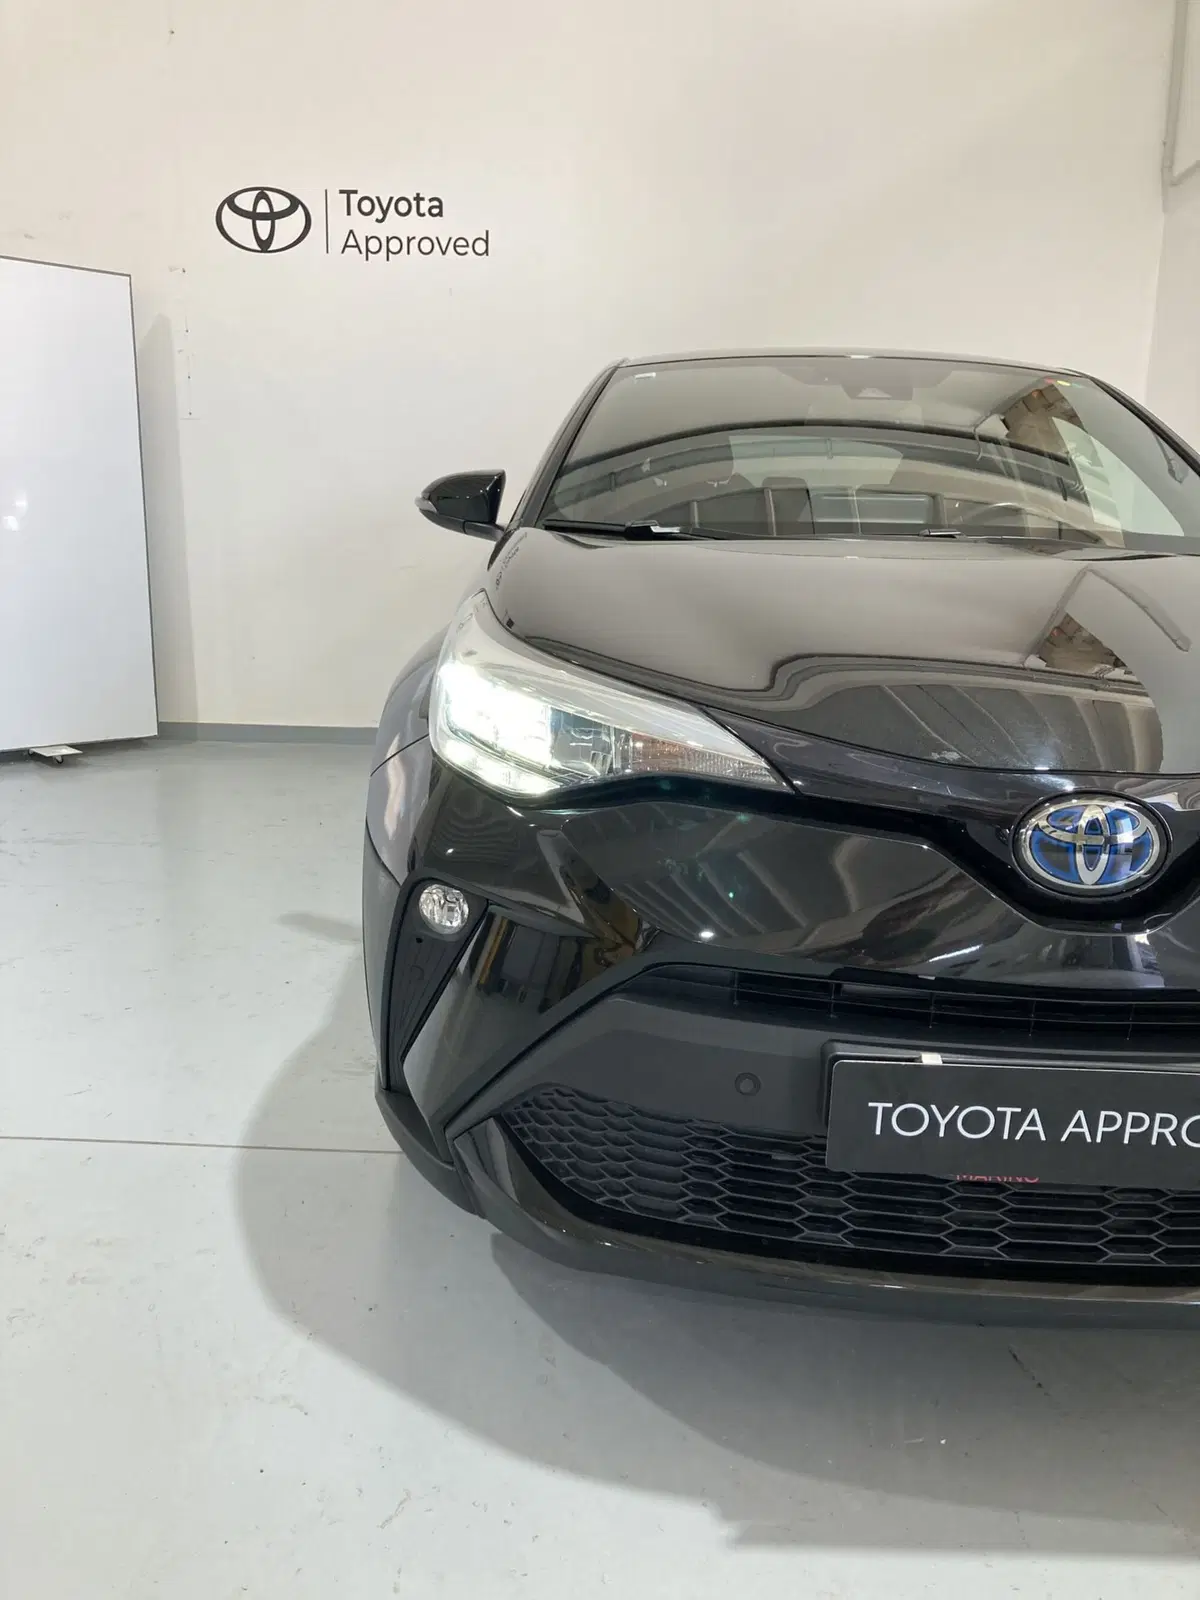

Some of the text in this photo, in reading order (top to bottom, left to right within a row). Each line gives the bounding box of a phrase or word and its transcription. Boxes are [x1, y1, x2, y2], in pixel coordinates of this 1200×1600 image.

[338, 189, 443, 223] Toyota
[341, 229, 489, 261] Approved
[868, 1102, 1046, 1141] TOYOTA
